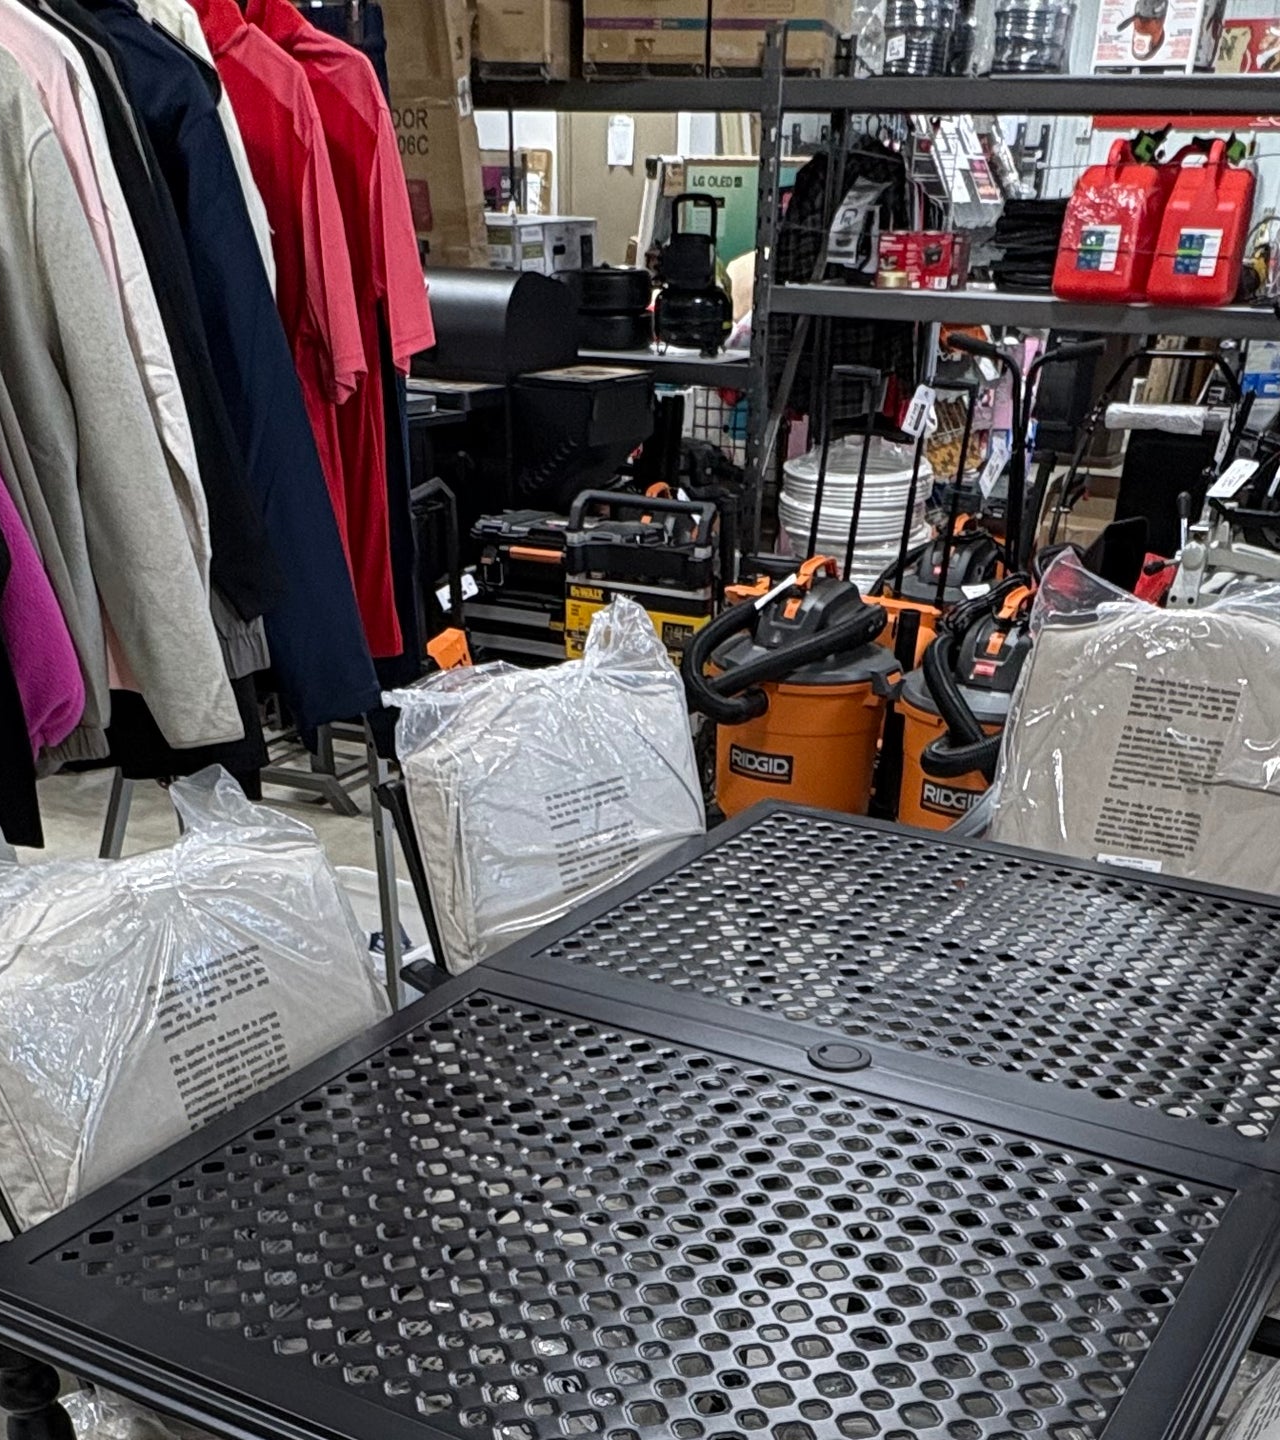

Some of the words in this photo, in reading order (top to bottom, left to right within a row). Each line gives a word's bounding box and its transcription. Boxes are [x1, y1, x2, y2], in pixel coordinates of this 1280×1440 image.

[692, 175, 705, 187] LG
[708, 175, 733, 188] OLED
[730, 748, 790, 776] RIDGID
